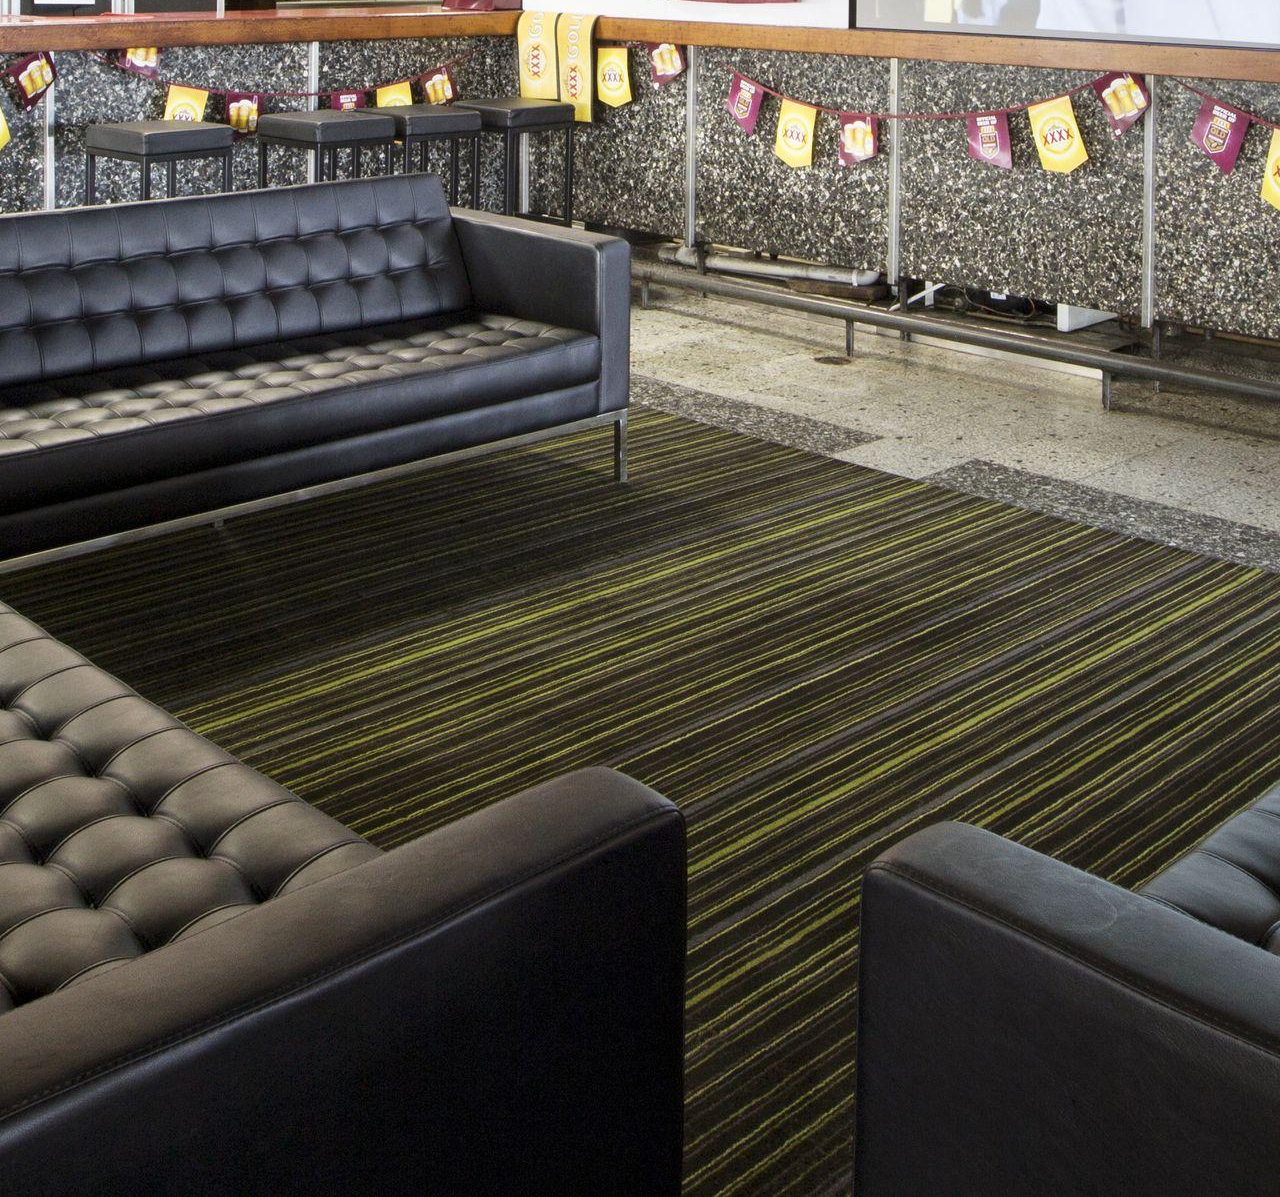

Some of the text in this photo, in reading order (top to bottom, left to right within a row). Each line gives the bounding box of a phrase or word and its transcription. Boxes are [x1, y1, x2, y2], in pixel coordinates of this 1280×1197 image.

[601, 70, 626, 84] XXXX
[783, 128, 807, 144] XXXX
[1043, 128, 1073, 147] XXXX
